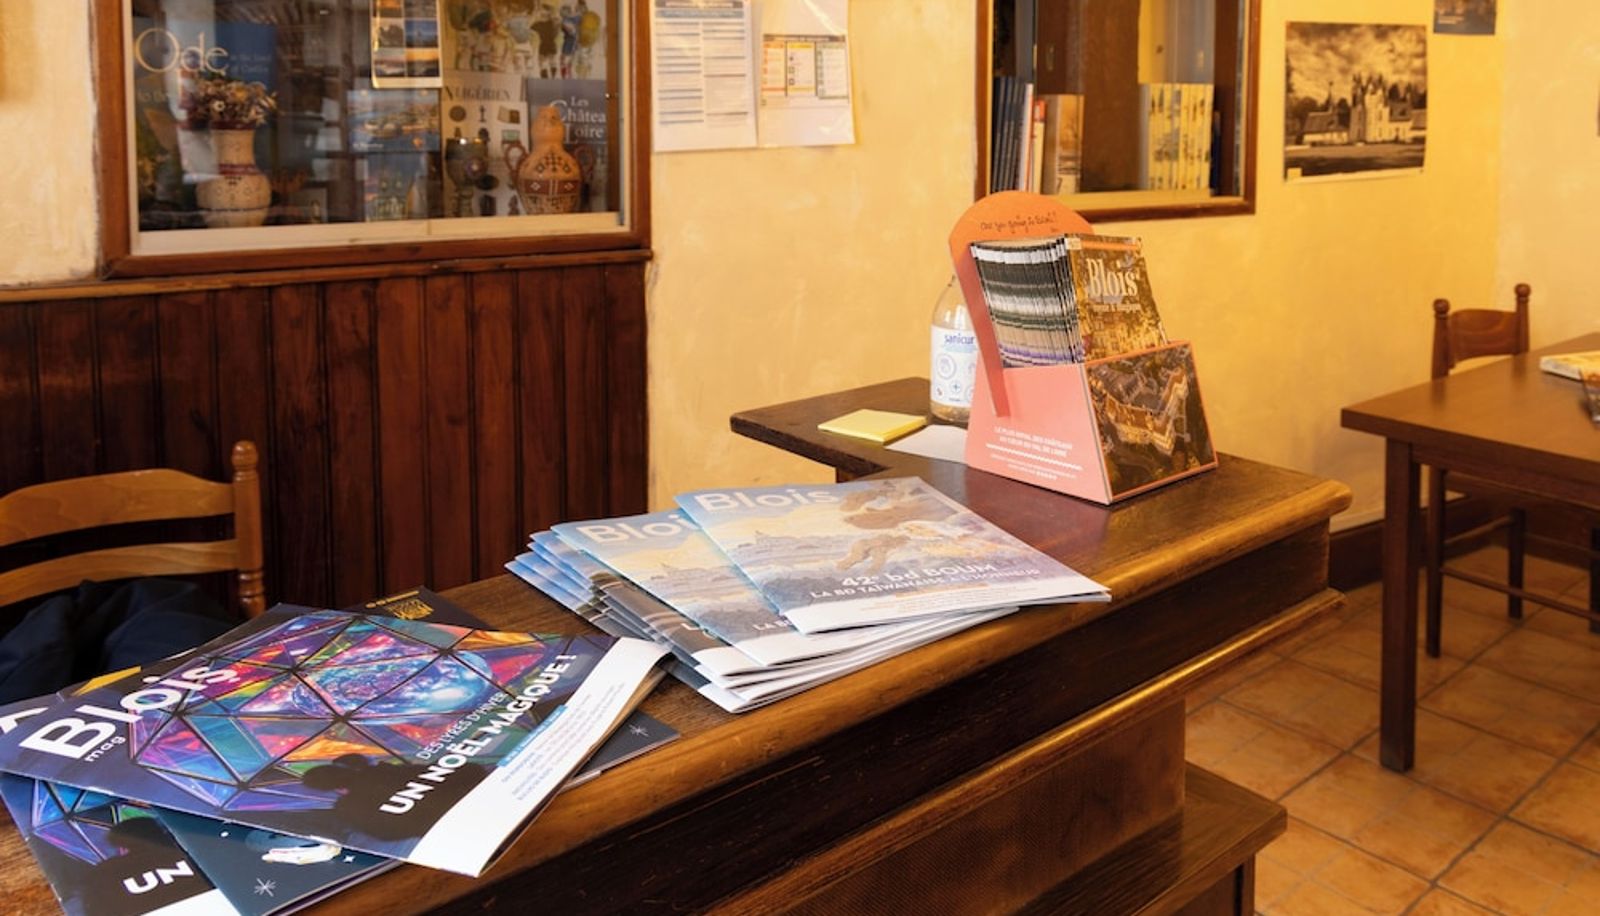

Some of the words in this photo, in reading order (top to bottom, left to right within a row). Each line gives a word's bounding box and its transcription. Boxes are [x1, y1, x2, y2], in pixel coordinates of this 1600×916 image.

[135, 27, 229, 76] Ode
[571, 96, 589, 107] Les
[563, 123, 605, 145] Loire
[1086, 258, 1138, 297] Blois
[694, 488, 838, 512] Blois
[886, 569, 919, 582] bd
[923, 563, 998, 578] BOUM
[810, 591, 833, 599] LA
[834, 588, 856, 597] BD
[18, 665, 240, 760] Blois
[85, 735, 126, 762] mag
[379, 781, 435, 816] UN
[420, 736, 492, 783] NOËL
[478, 662, 570, 735] MAGIQUE
[415, 741, 444, 760] DES
[440, 719, 473, 743] LYRES
[122, 860, 194, 895] UN
